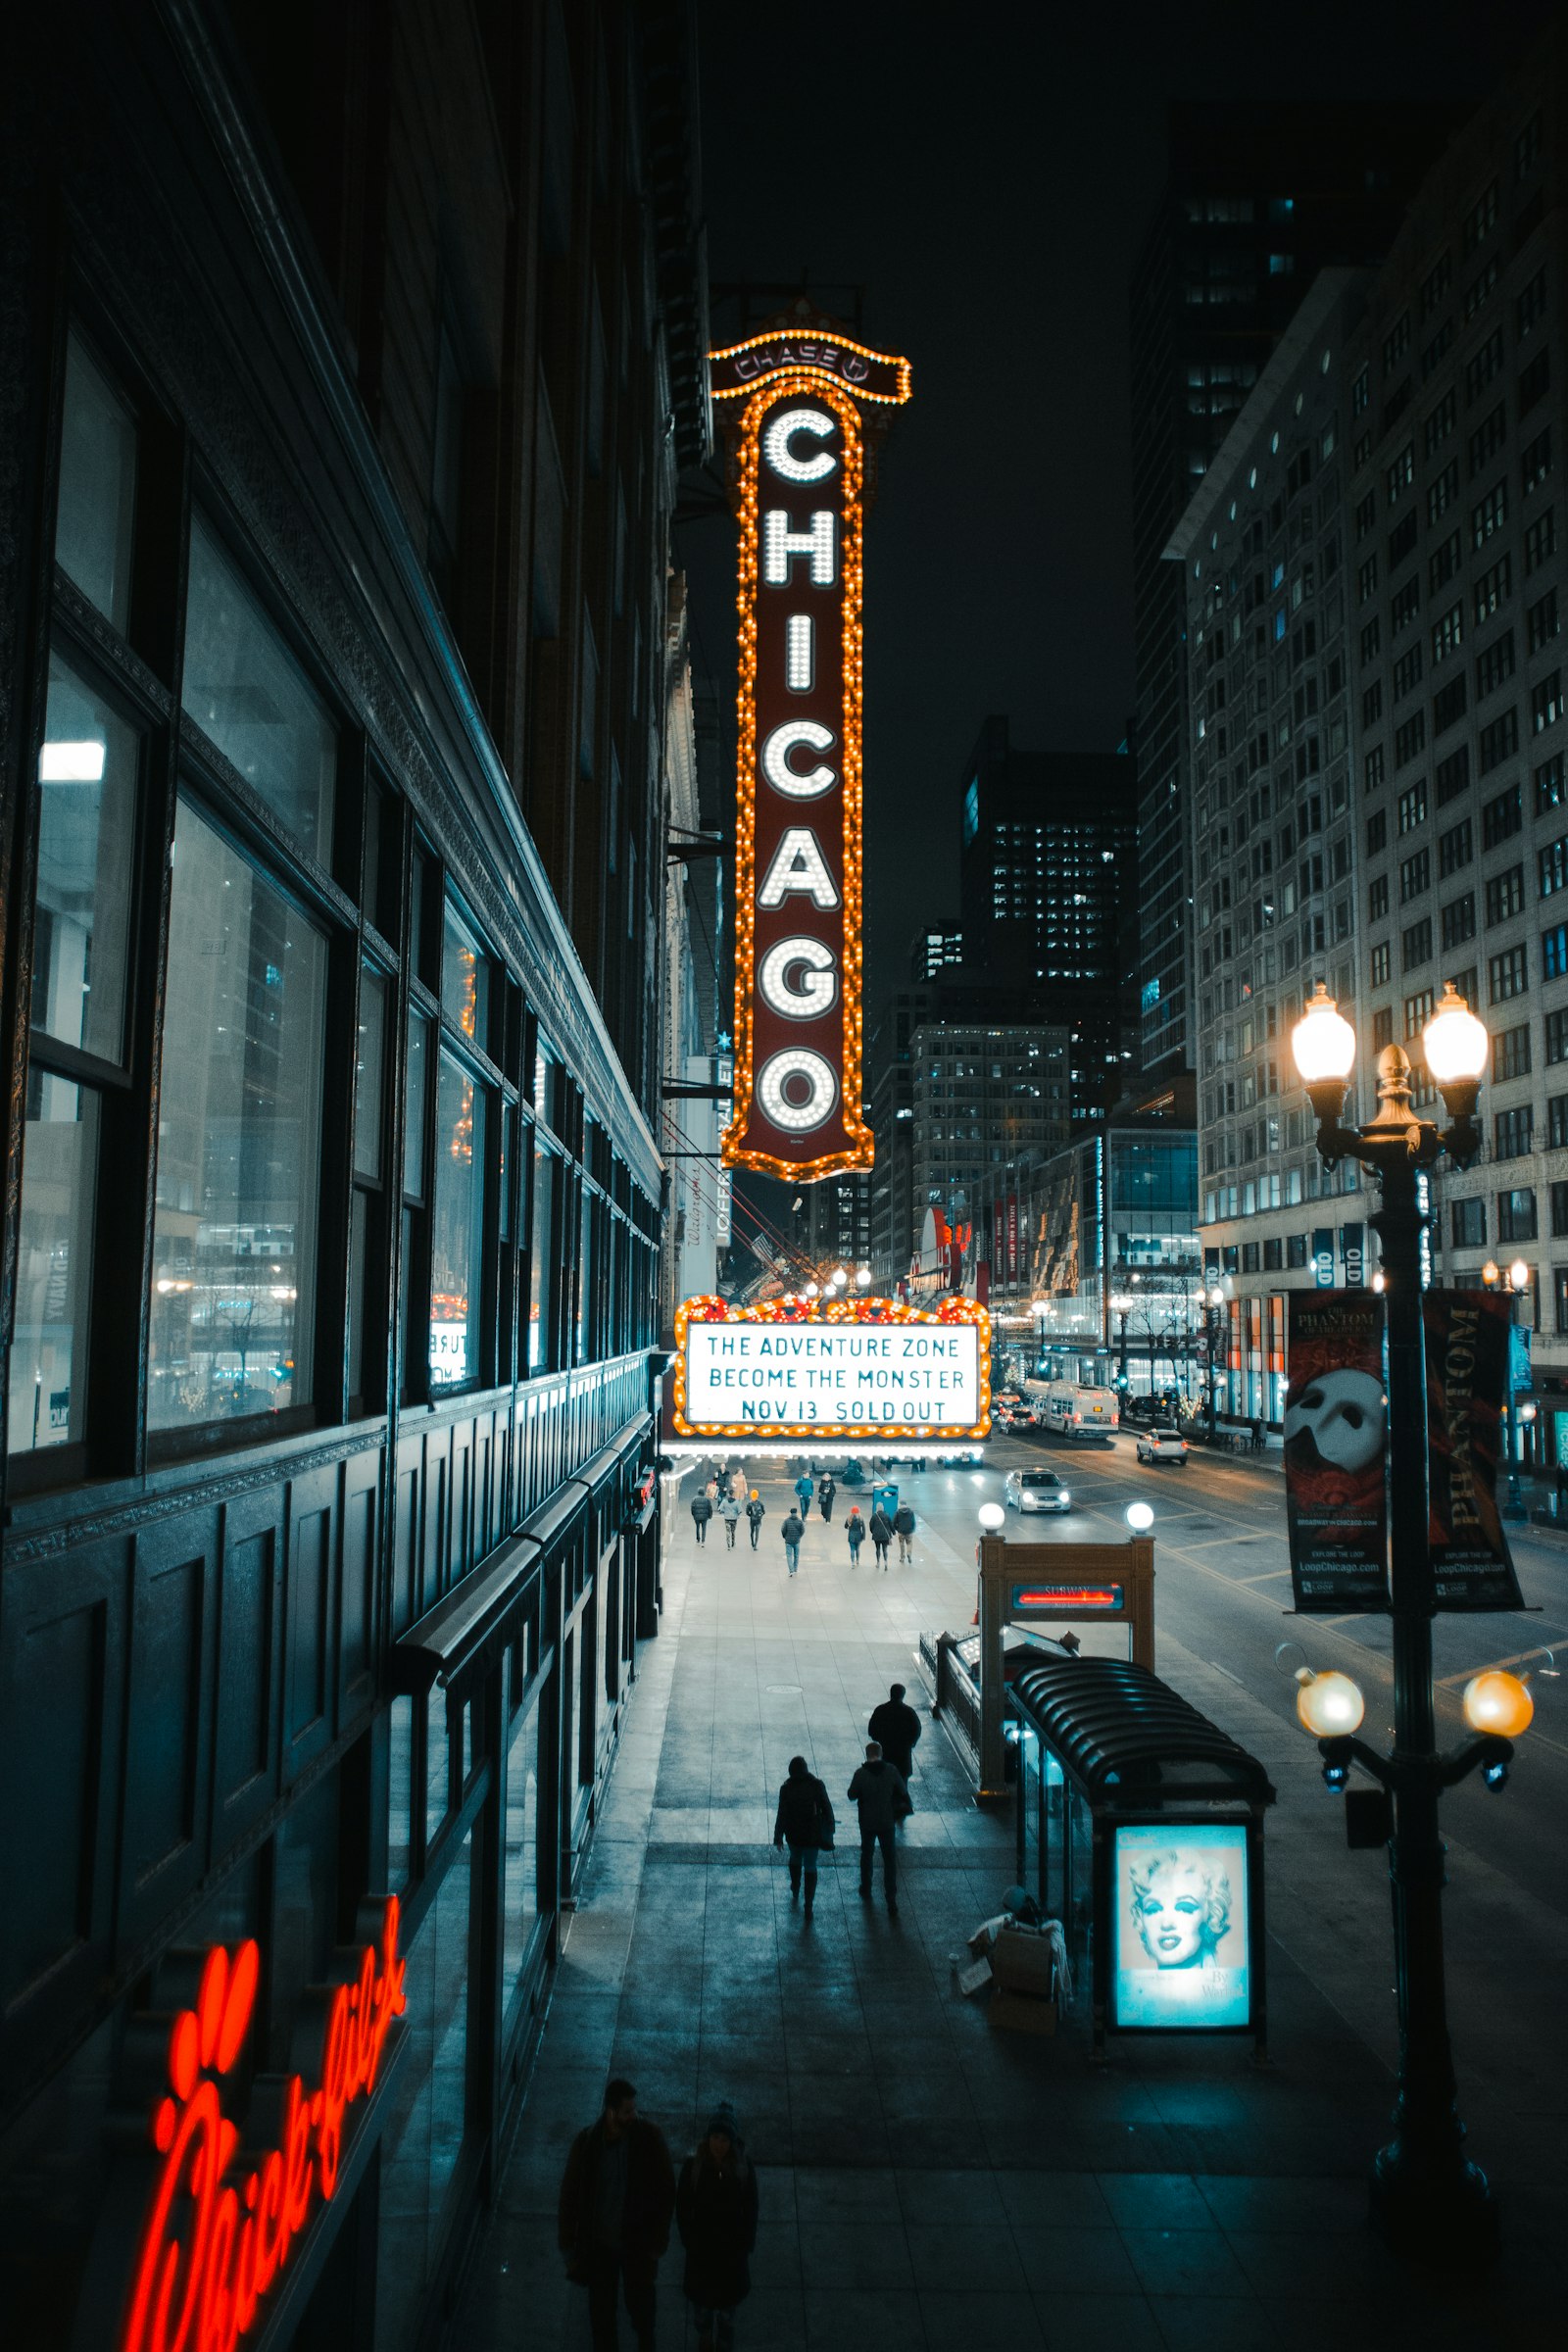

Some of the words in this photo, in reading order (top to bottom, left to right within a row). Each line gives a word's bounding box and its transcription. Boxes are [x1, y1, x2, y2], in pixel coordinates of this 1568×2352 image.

[735, 344, 839, 379] CHASE
[758, 408, 839, 1133] CHICAGO
[687, 1165, 704, 1248] Walgreens
[1096, 1224, 1104, 1268] BLOCK
[1317, 1251, 1333, 1285] OLD
[1347, 1248, 1361, 1282] OLD
[1298, 1313, 1374, 1327] PHANTOM
[708, 1337, 751, 1355] THE
[760, 1337, 892, 1357] ADVENTURE
[903, 1338, 958, 1357] ZONE
[710, 1368, 797, 1388] BECOME
[806, 1369, 847, 1388] THE
[858, 1370, 964, 1389] MONSTER
[742, 1400, 788, 1420] NOV
[798, 1400, 817, 1420] 13
[836, 1401, 895, 1420] SOLD
[902, 1402, 946, 1421] OUT
[1445, 1305, 1480, 1528] PHANTOM
[1299, 1561, 1380, 1574] LoopChicago.com
[1433, 1563, 1506, 1574] LoopChicago.com
[1045, 1586, 1090, 1596] SUBWAY
[1212, 1971, 1228, 1984] By
